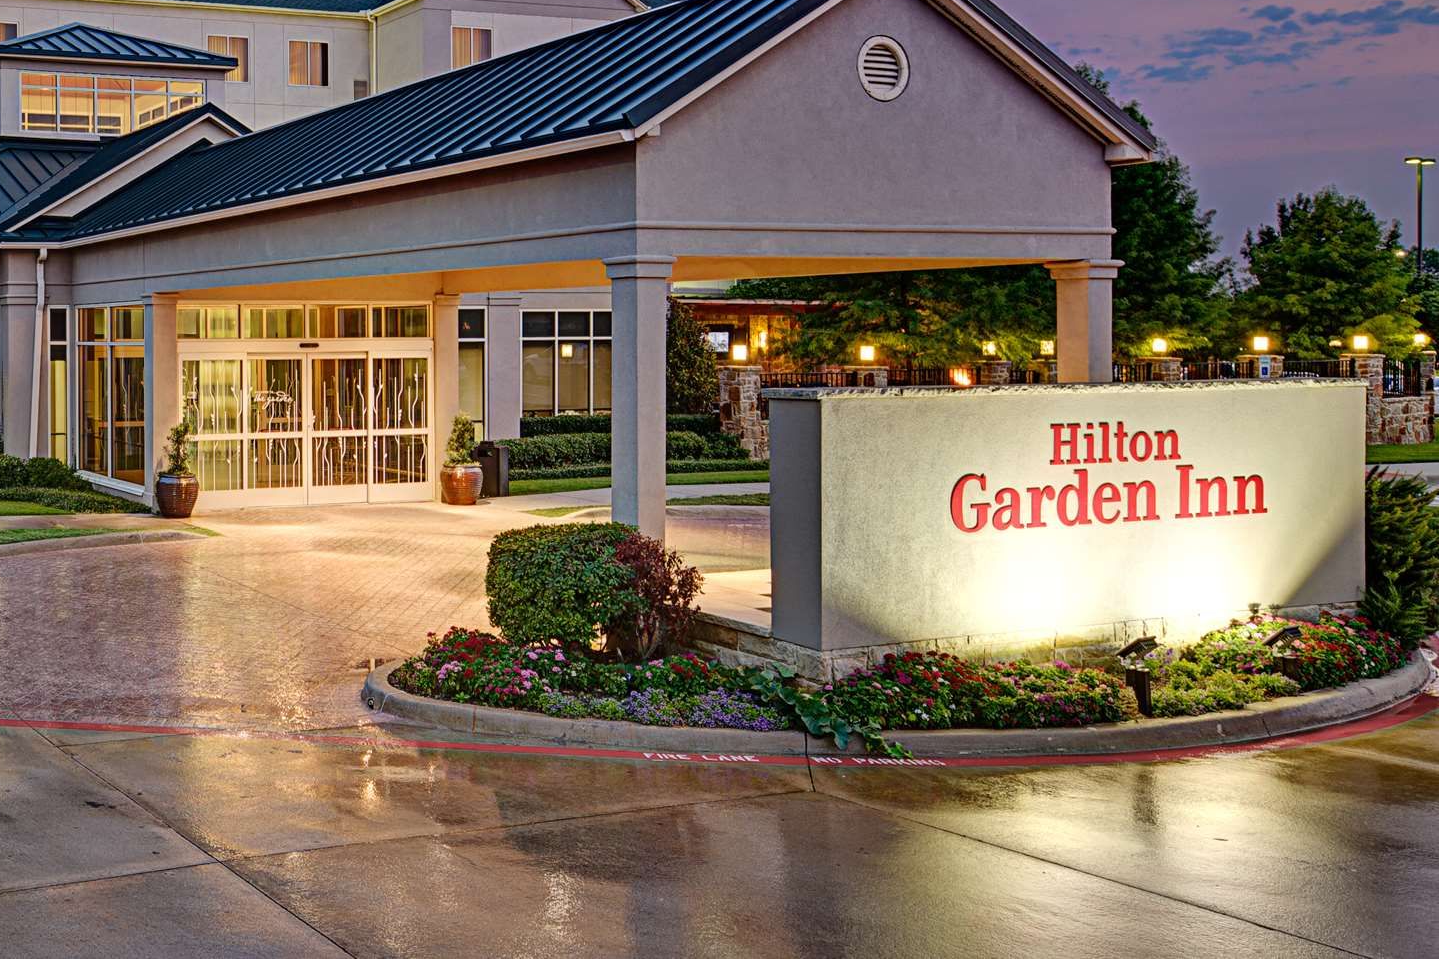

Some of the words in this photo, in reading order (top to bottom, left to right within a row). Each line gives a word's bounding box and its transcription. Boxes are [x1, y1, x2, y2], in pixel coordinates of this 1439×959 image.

[1049, 421, 1181, 465] Hilton
[950, 468, 1160, 533] Garden
[1175, 464, 1268, 519] Inn
[643, 752, 691, 761] FIRE
[701, 754, 759, 762] LANE
